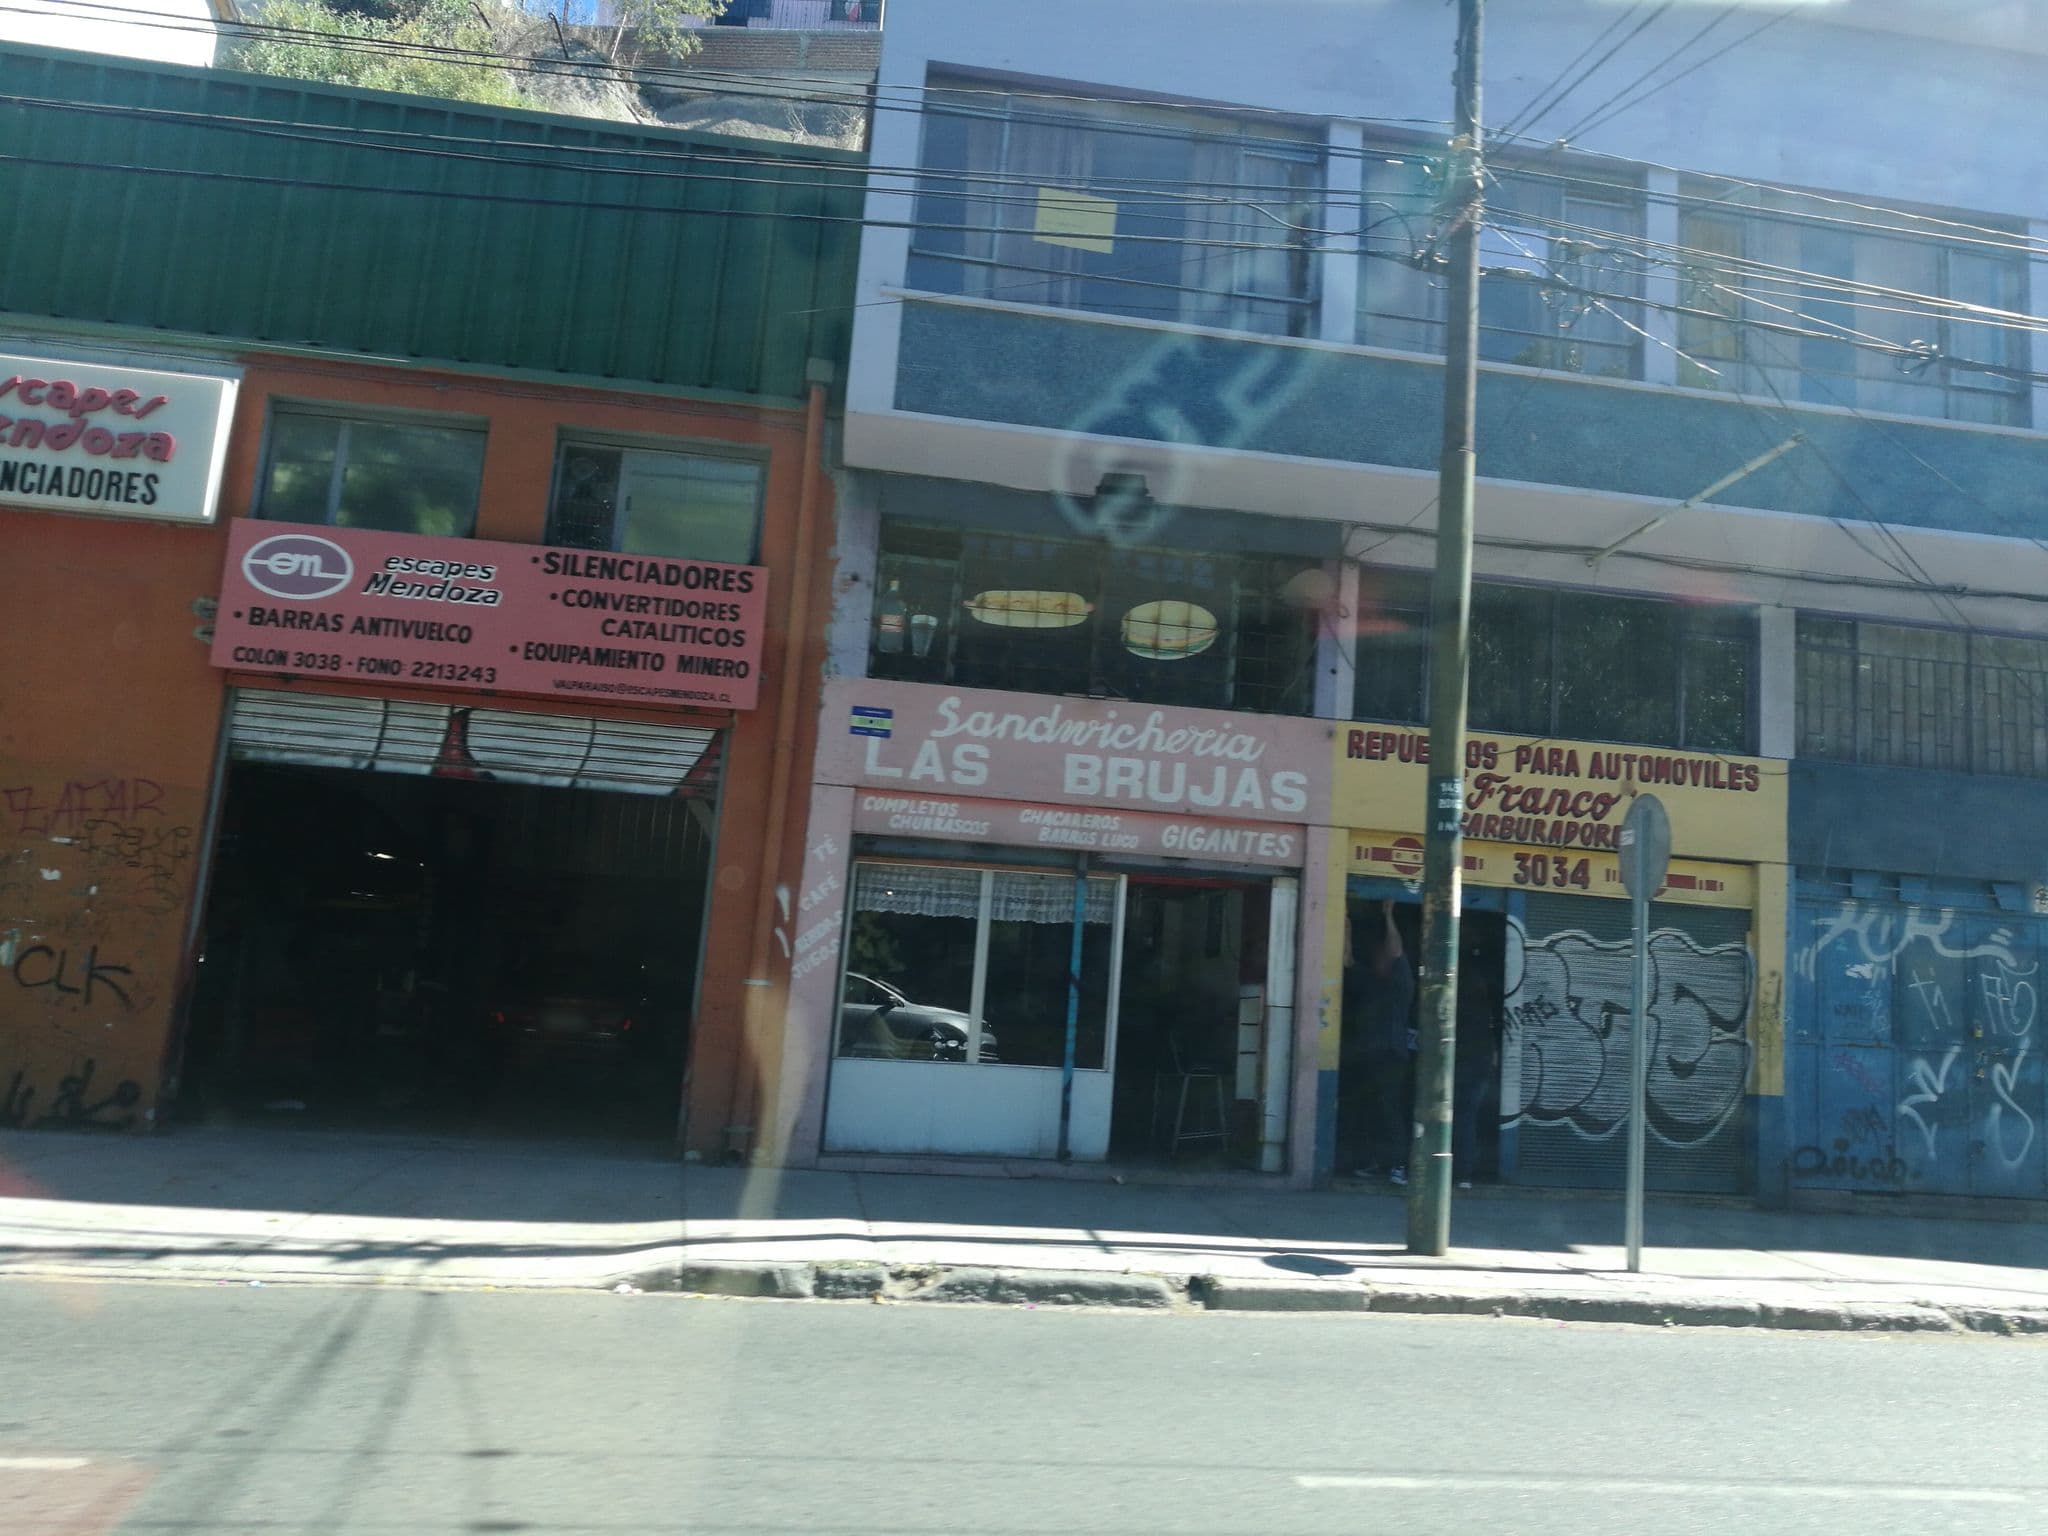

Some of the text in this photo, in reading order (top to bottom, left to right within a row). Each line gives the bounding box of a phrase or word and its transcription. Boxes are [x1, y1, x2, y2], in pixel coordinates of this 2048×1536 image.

[384, 555, 498, 581] escapes
[542, 552, 754, 594] SILENCIADORES
[361, 573, 503, 607] Mendoza
[562, 589, 742, 622] CONVERTIDORES
[247, 606, 472, 644] BARRAS ANTIVUELCO
[601, 618, 746, 648] CATALITICOS
[232, 646, 497, 684] COLON 3038 FONO 2213243
[523, 641, 750, 679] EQUIPAMIENTO MINERO
[864, 737, 1308, 813] LAS BRUJAS
[1347, 729, 1760, 792] REPUEOS PARA AUTOMOVILES
[863, 796, 959, 818] COMPLETOS
[1466, 772, 1622, 821] Franco
[1161, 824, 1295, 859] GIGANTES
[1459, 812, 1623, 848] CARBURADORE
[1513, 852, 1591, 889] 3034
